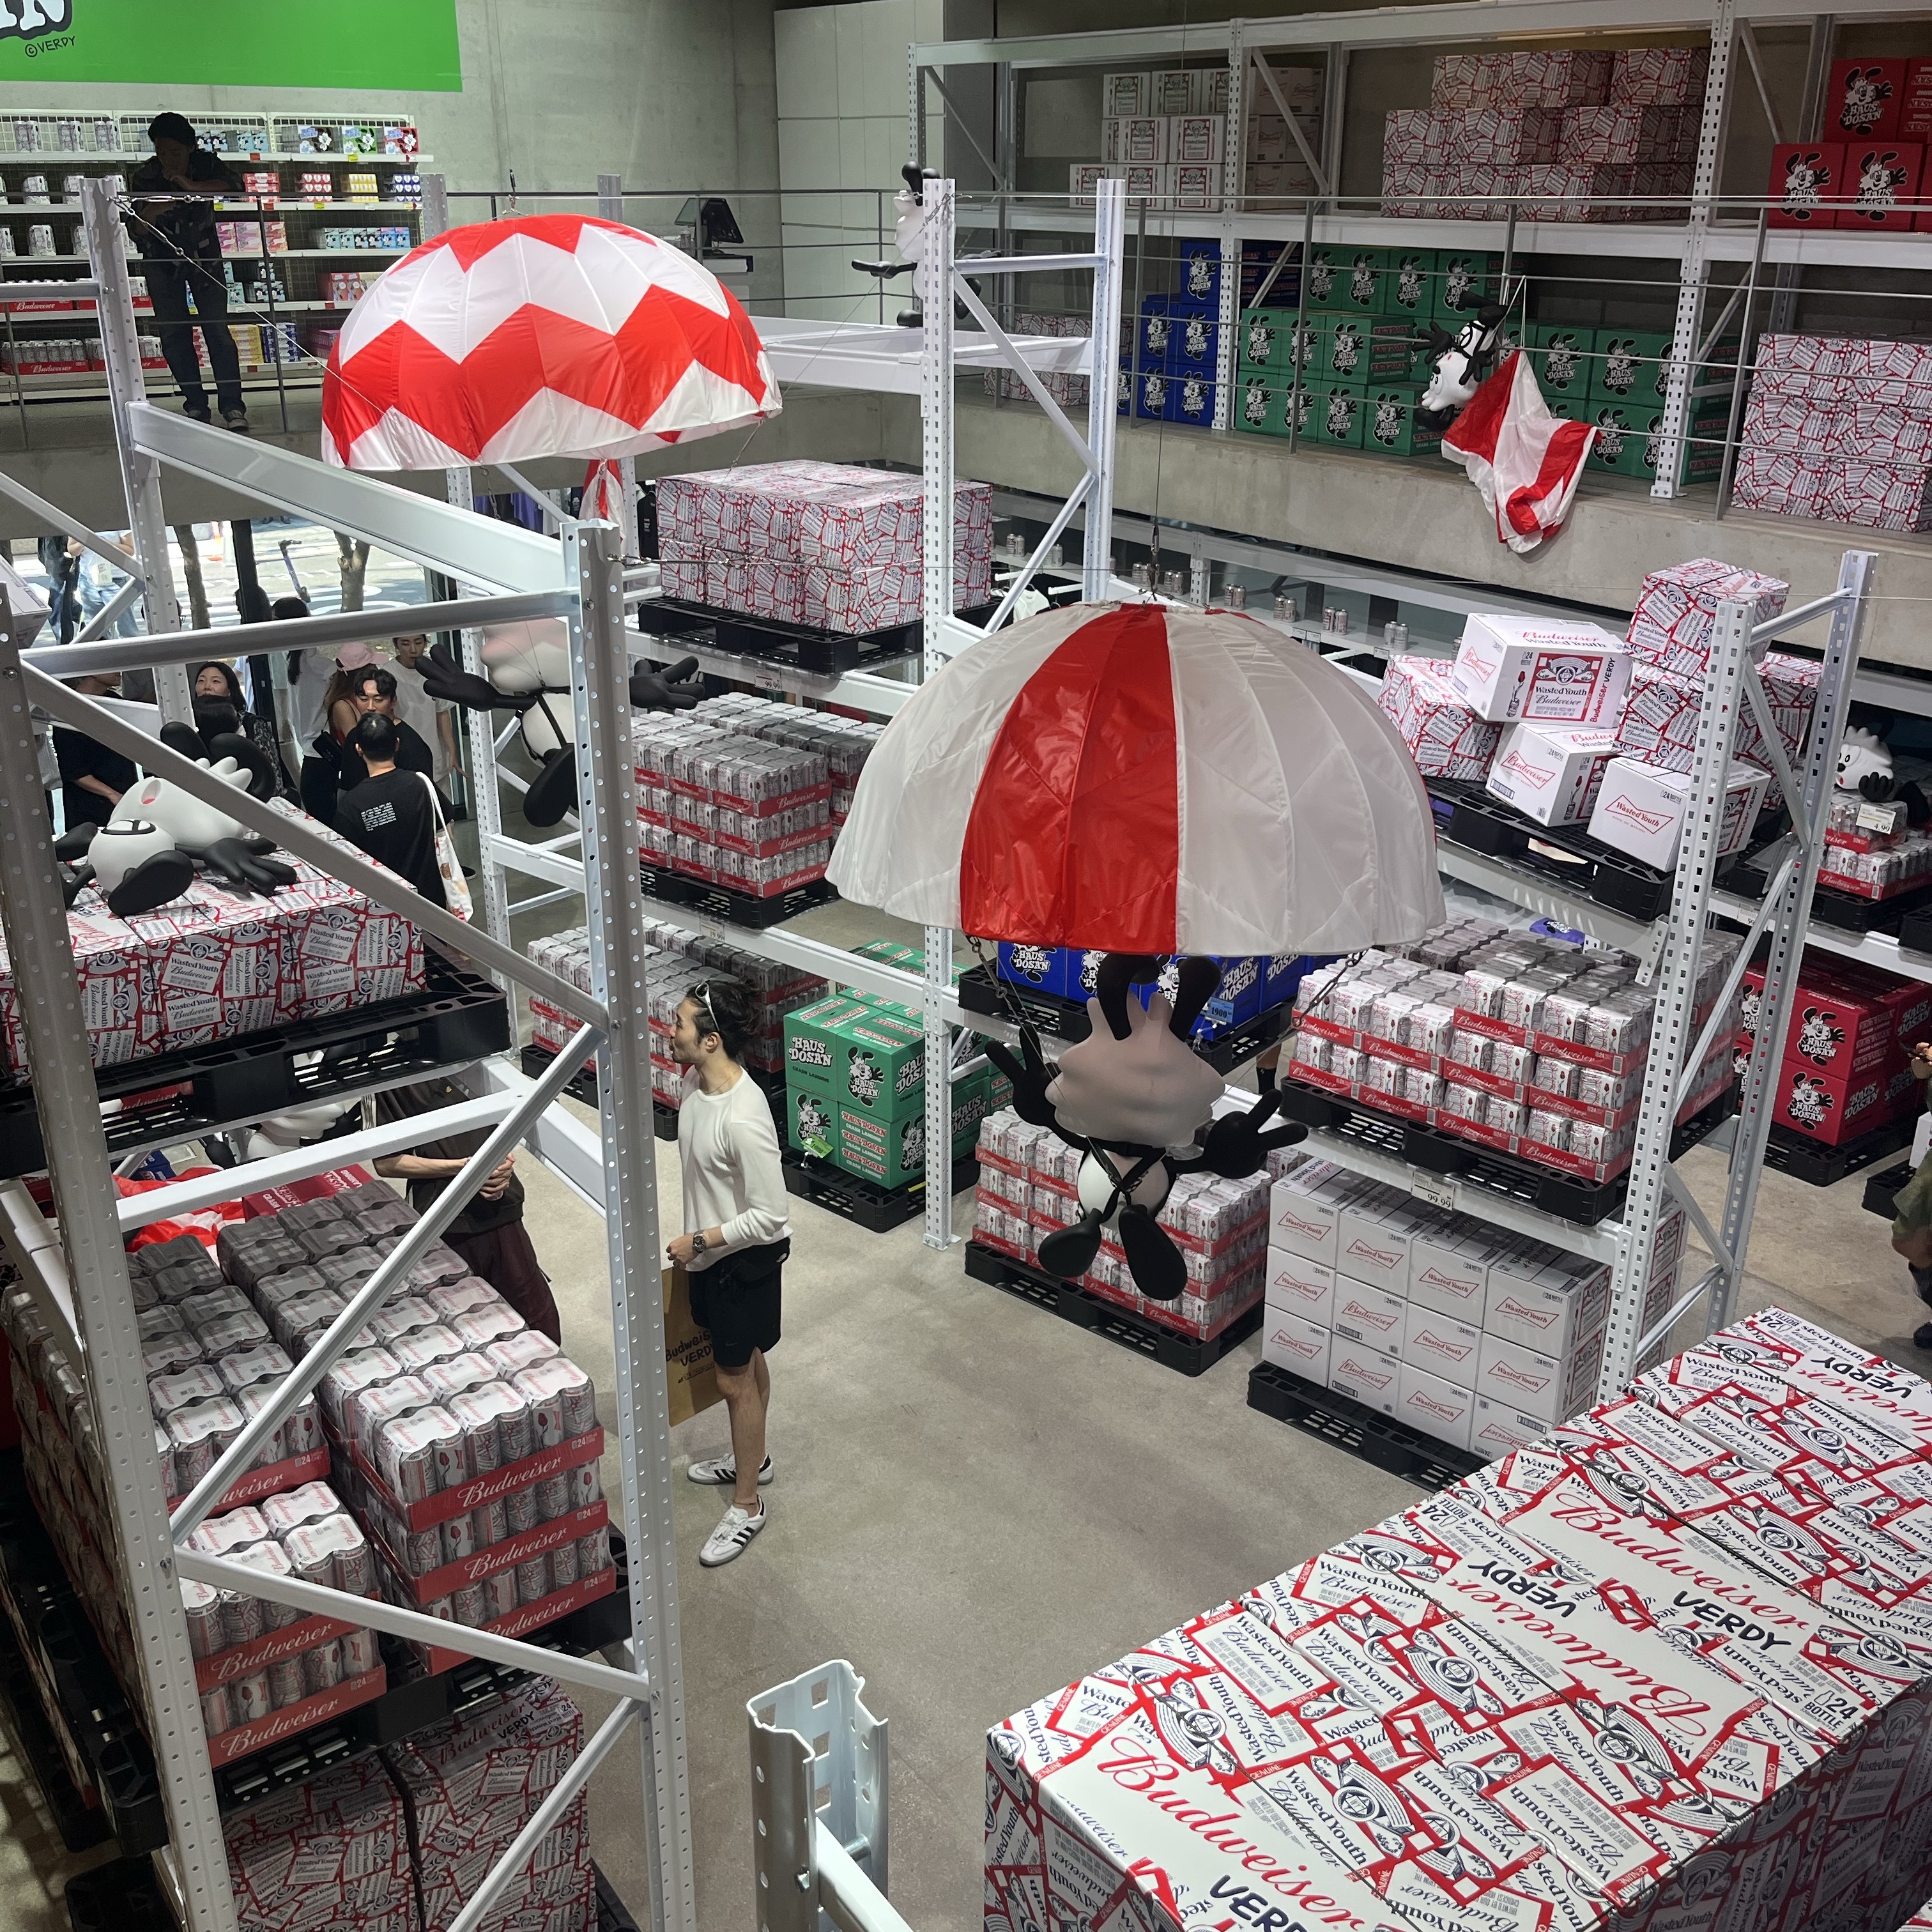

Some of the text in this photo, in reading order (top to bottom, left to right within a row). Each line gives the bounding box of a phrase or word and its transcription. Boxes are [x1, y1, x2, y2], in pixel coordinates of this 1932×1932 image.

[1844, 110, 1882, 125] DOSAN
[1850, 102, 1878, 114] HAUS
[1547, 370, 1575, 379] DOSAN
[1552, 364, 1571, 372] HAUS
[1611, 370, 1632, 378] HAUS
[1605, 376, 1635, 385] DOSAN
[1376, 427, 1400, 437] DOSAN
[1600, 438, 1621, 447] HAUS
[1597, 445, 1623, 455] DOSAN
[1515, 631, 1600, 642] Budweiser
[1466, 649, 1491, 677] Budweiser
[1535, 686, 1587, 696] Wasted Youth
[1535, 694, 1582, 706] Budweiser
[1590, 657, 1616, 723] Budweiser VERDY
[1507, 753, 1548, 783] Budweiser
[777, 792, 816, 809] Budweiser
[1663, 791, 1670, 799] 24
[1616, 801, 1641, 818] Wasted
[1640, 813, 1660, 827] Youth
[778, 832, 817, 850] Budweiser
[781, 870, 818, 890] Budweiser
[309, 927, 355, 943] Wasted Youth
[309, 935, 349, 951] Budweiser
[171, 957, 220, 974] Wasted Youth
[1013, 958, 1050, 971] DOSAN
[1018, 951, 1044, 962] HAUS
[170, 965, 214, 981] Budweiser
[305, 965, 353, 979] Wasted Youth
[308, 975, 351, 988] Budweiser
[1219, 962, 1260, 1001] DOSAN
[1223, 956, 1254, 989] HAUS
[168, 995, 219, 1012] Wasted Youth
[171, 1006, 217, 1021] Budweiser
[1211, 1007, 1227, 1018] 1900
[1457, 1012, 1509, 1038] Budweiser
[792, 1036, 827, 1055] HAUS
[1367, 1041, 1416, 1062] Budweiser
[1539, 1039, 1596, 1062] Budweiser
[1802, 1045, 1837, 1058] DOSAN
[1808, 1038, 1834, 1050] HAUS
[788, 1047, 833, 1067] DOSAN
[854, 1077, 875, 1089] HAUS
[1291, 1064, 1337, 1088] Budweiser
[850, 1084, 880, 1098] DOSAN
[1850, 1082, 1878, 1105] HAUS
[1532, 1093, 1587, 1117] Budweiser
[1791, 1108, 1827, 1123] DOSAN
[1796, 1101, 1821, 1114] HAUS
[1844, 1093, 1880, 1120] DOSAN
[1441, 1117, 1493, 1141] Budweiser
[1524, 1143, 1580, 1169] Budweiser
[1427, 1193, 1452, 1208] 99.99
[1285, 1217, 1322, 1236] Wasted Youth
[1427, 1273, 1469, 1293] Wasted Youth
[1346, 1302, 1392, 1327] Budweiser
[1505, 1303, 1548, 1324] Wasted Youth
[1759, 1310, 1798, 1331] 24 BOTTLE
[666, 1330, 710, 1362] Budweis
[1824, 1337, 1866, 1362] Youth
[1685, 1356, 1785, 1385] Wasted Youth
[1689, 1365, 1779, 1394] Budweiser
[1809, 1356, 1912, 1399] VERDY
[1692, 1413, 1772, 1465] Budweiser
[1701, 1406, 1788, 1461] Wasted Youth
[301, 1455, 312, 1466] 24
[457, 1437, 586, 1508] Budweiser 24
[1422, 1497, 1469, 1523] 24 BOTTLE
[464, 1508, 592, 1580] Budweiser 24
[1549, 1492, 1810, 1632] Budweiser
[1468, 1560, 1576, 1619] VERDY
[1204, 1611, 1234, 1627] GENUINE
[1673, 1590, 1792, 1651] VERDY
[211, 1623, 333, 1680] Budweiser
[1222, 1623, 1294, 1692] Budweiser
[1236, 1614, 1282, 1658] Wasted
[1276, 1651, 1315, 1690] Youth
[1445, 1577, 1711, 1739] Budweiser
[220, 1677, 367, 1757] Budweiser 24
[561, 1703, 572, 1713] 24
[1804, 1696, 1859, 1729] 24 BOTTLE
[429, 1702, 536, 1766] Budweiser VERDY
[1032, 1758, 1066, 1782] GENUINE
[1510, 1786, 1555, 1832] Youth
[1096, 1736, 1365, 1931] Budweiser
[1532, 1782, 1623, 1867] Budweiser
[1209, 1874, 1307, 1932] VER
